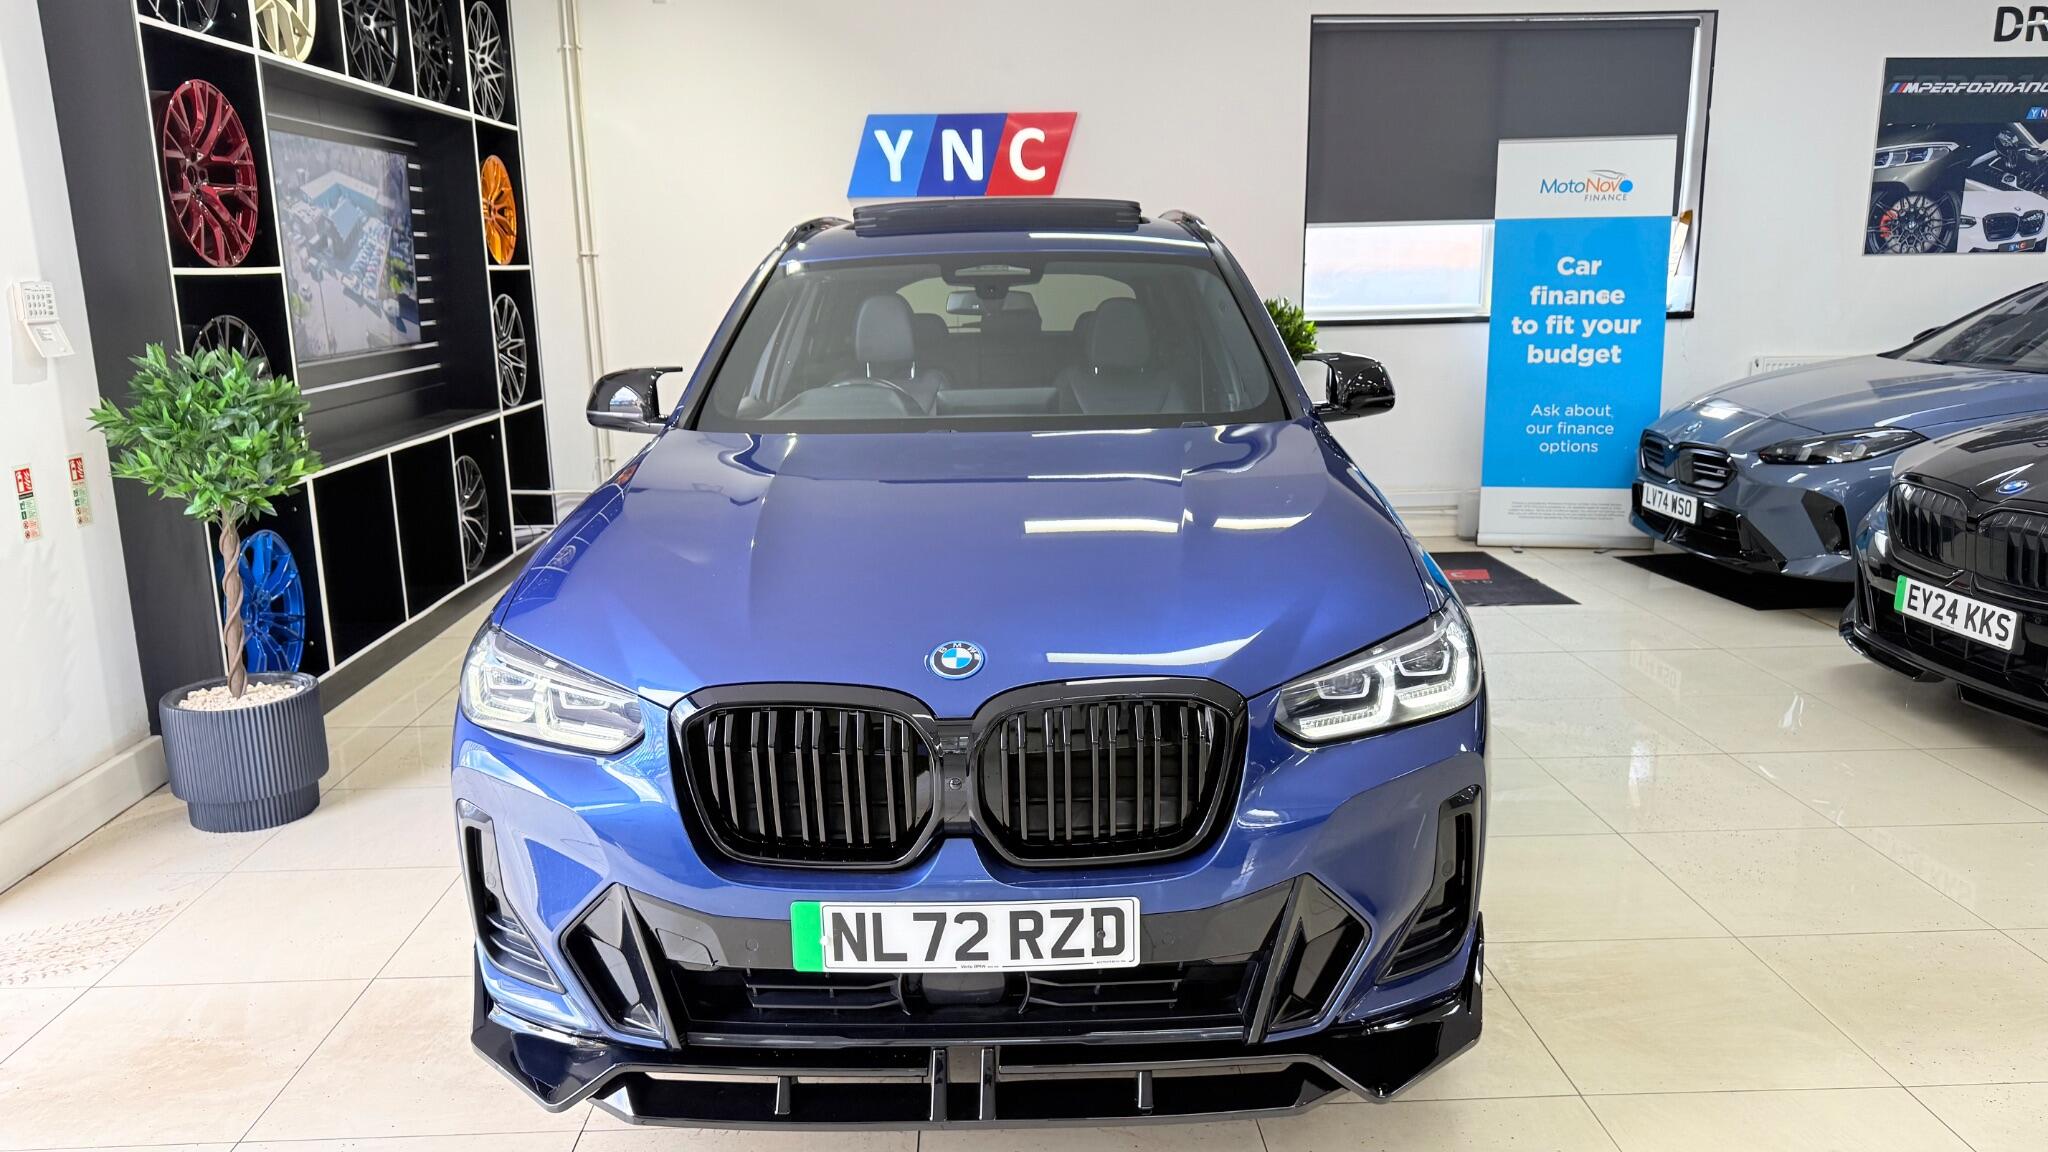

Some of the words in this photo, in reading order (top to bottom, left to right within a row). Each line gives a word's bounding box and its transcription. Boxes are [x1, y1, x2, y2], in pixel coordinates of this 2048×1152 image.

[873, 127, 1046, 182] YNC
[1540, 177, 1633, 195] MotoNovo
[1557, 256, 1602, 276] Car
[1530, 286, 1626, 305] finance
[1511, 317, 1538, 335] to
[1546, 316, 1575, 335] fit
[1582, 318, 1642, 338] your
[1527, 344, 1622, 367] budget
[1531, 404, 1560, 417] Ask
[1564, 403, 1611, 417] about
[1526, 424, 1553, 435] our
[1557, 421, 1614, 435] finance
[1539, 438, 1598, 454] options
[1646, 485, 1668, 511] LV74
[1907, 584, 1958, 625] EY24
[1964, 603, 2011, 642] KKS
[831, 911, 989, 962] NL72
[1009, 906, 1126, 960] RZD
